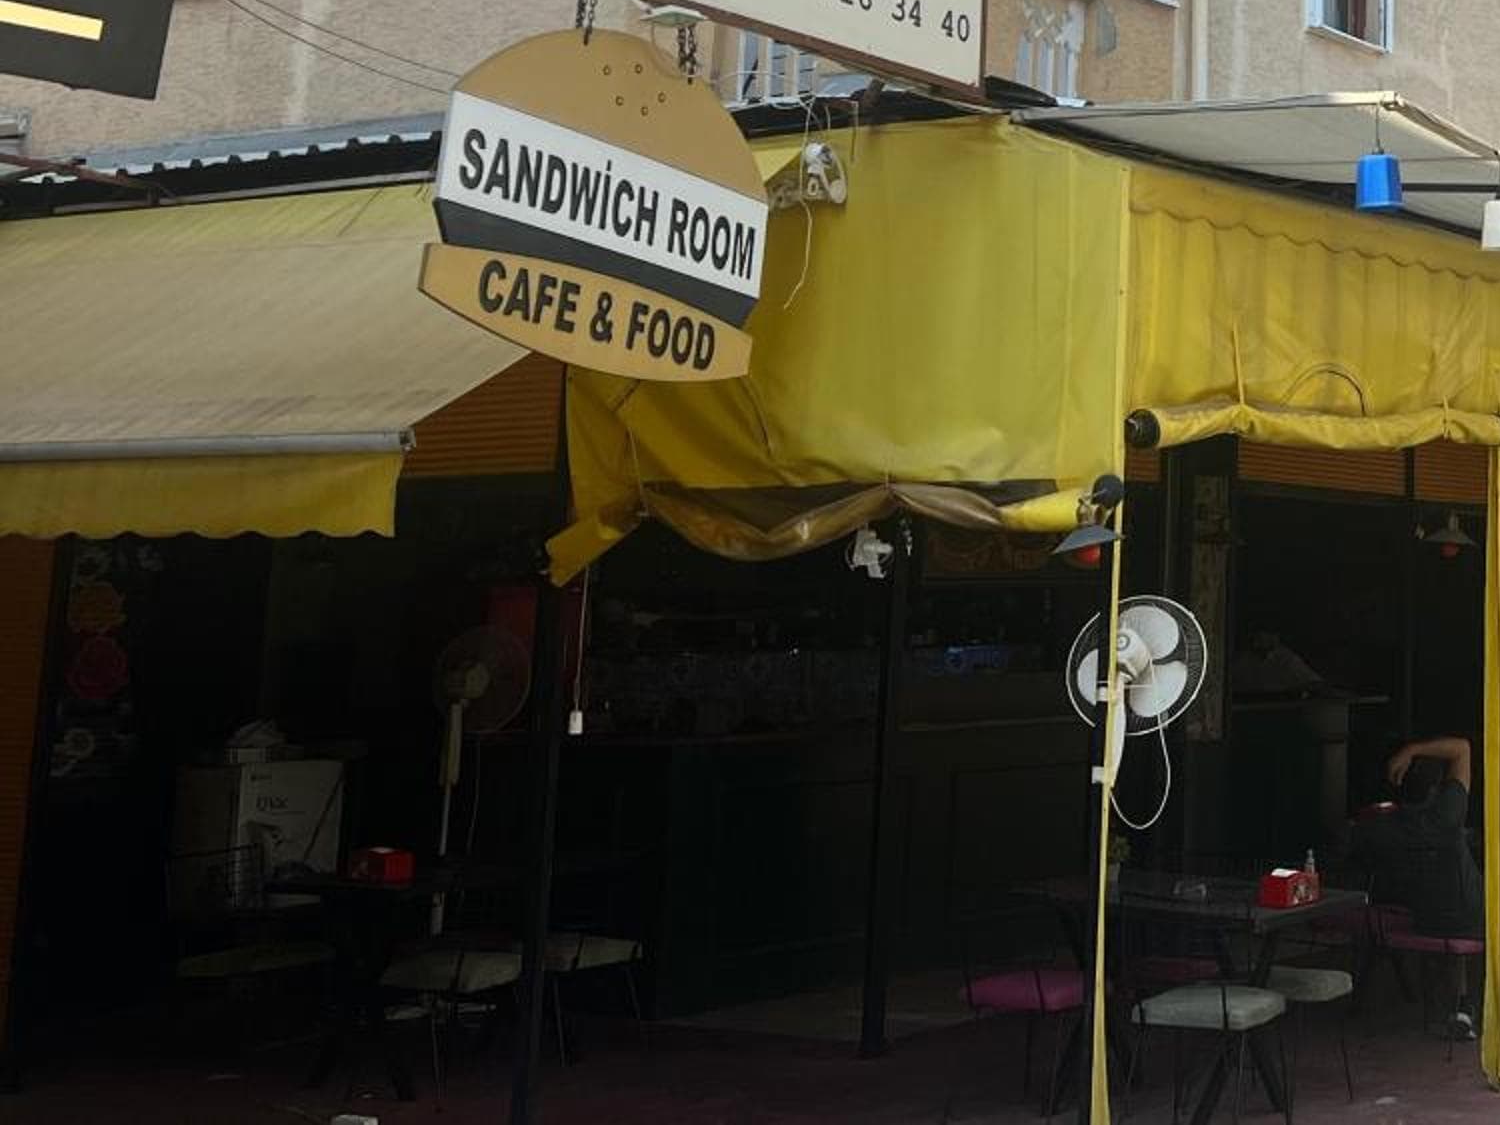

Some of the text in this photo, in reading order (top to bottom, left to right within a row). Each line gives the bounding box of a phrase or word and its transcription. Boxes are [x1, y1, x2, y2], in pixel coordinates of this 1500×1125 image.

[941, 10, 970, 42] 40
[459, 128, 756, 280] SANDWİCH ROOM
[478, 260, 716, 371] CAFE & FOOD
